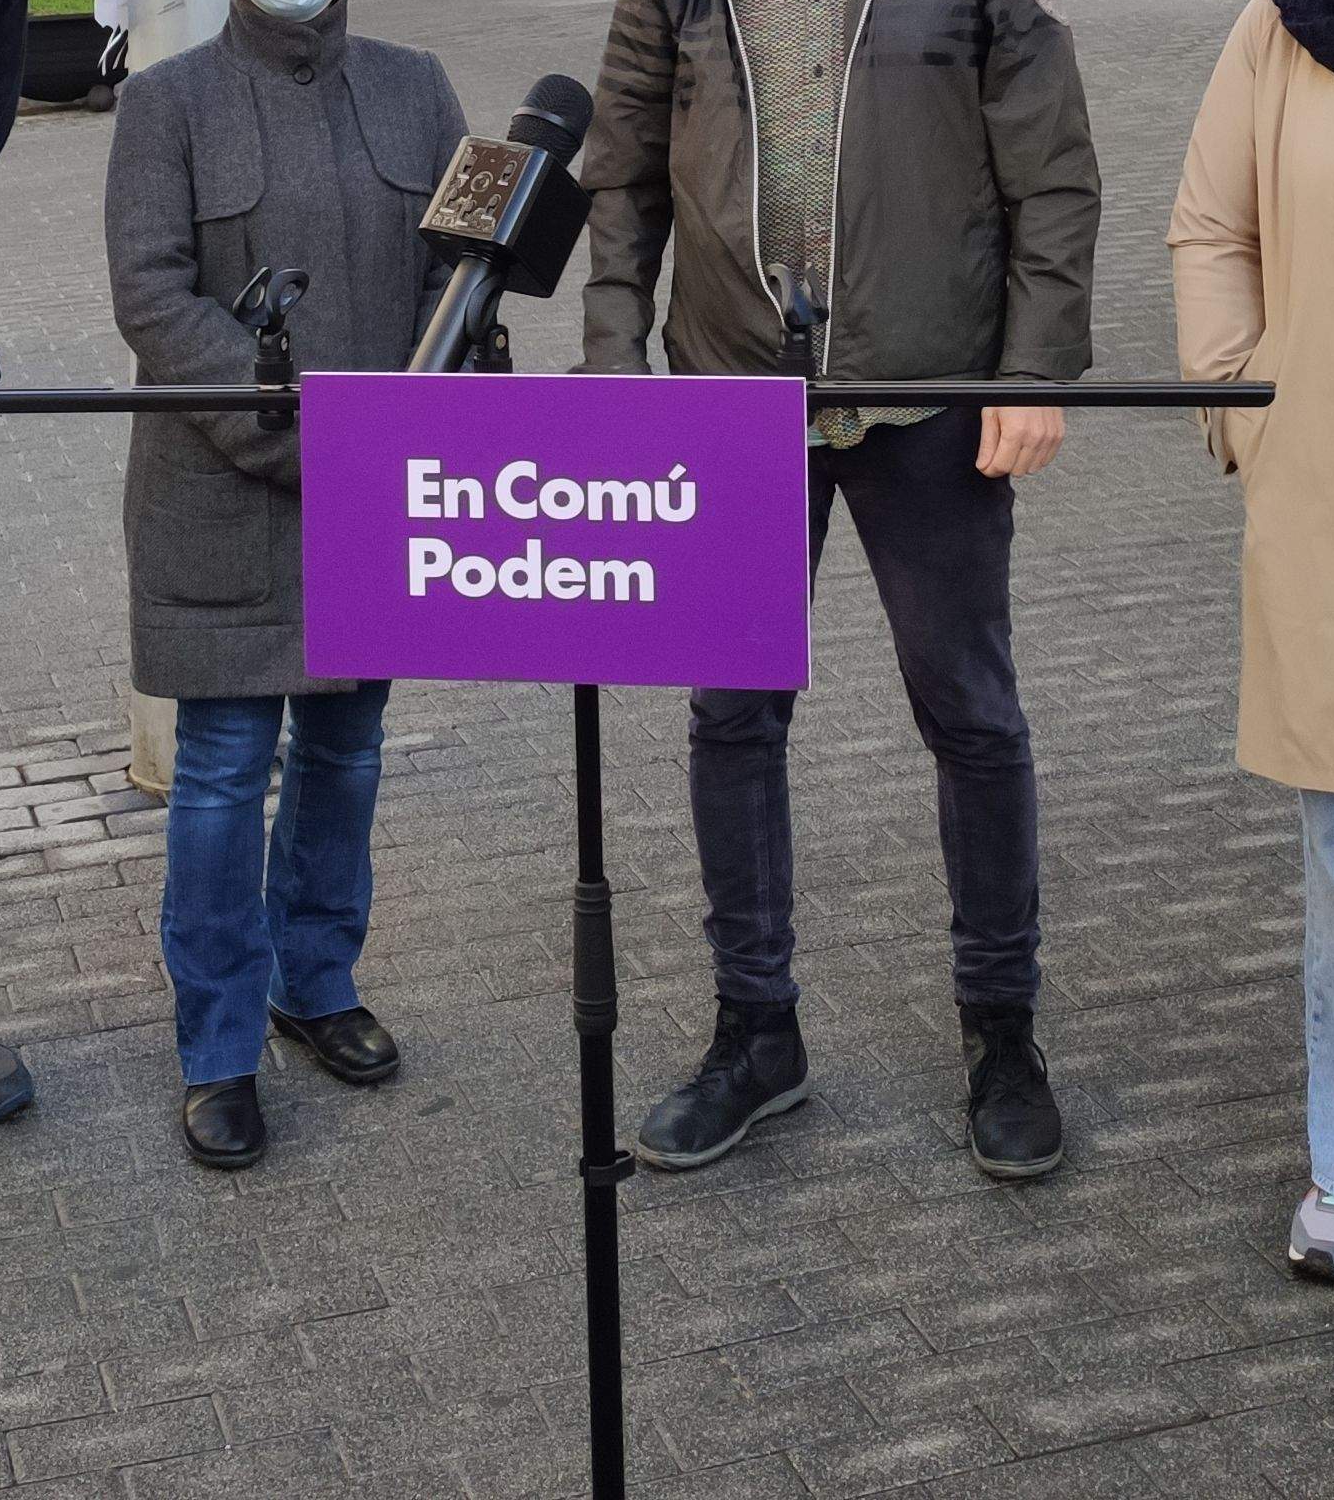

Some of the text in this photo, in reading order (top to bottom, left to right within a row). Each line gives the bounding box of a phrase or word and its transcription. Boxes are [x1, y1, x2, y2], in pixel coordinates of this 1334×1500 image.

[407, 459, 696, 521] En Comú
[408, 538, 655, 601] Podem
